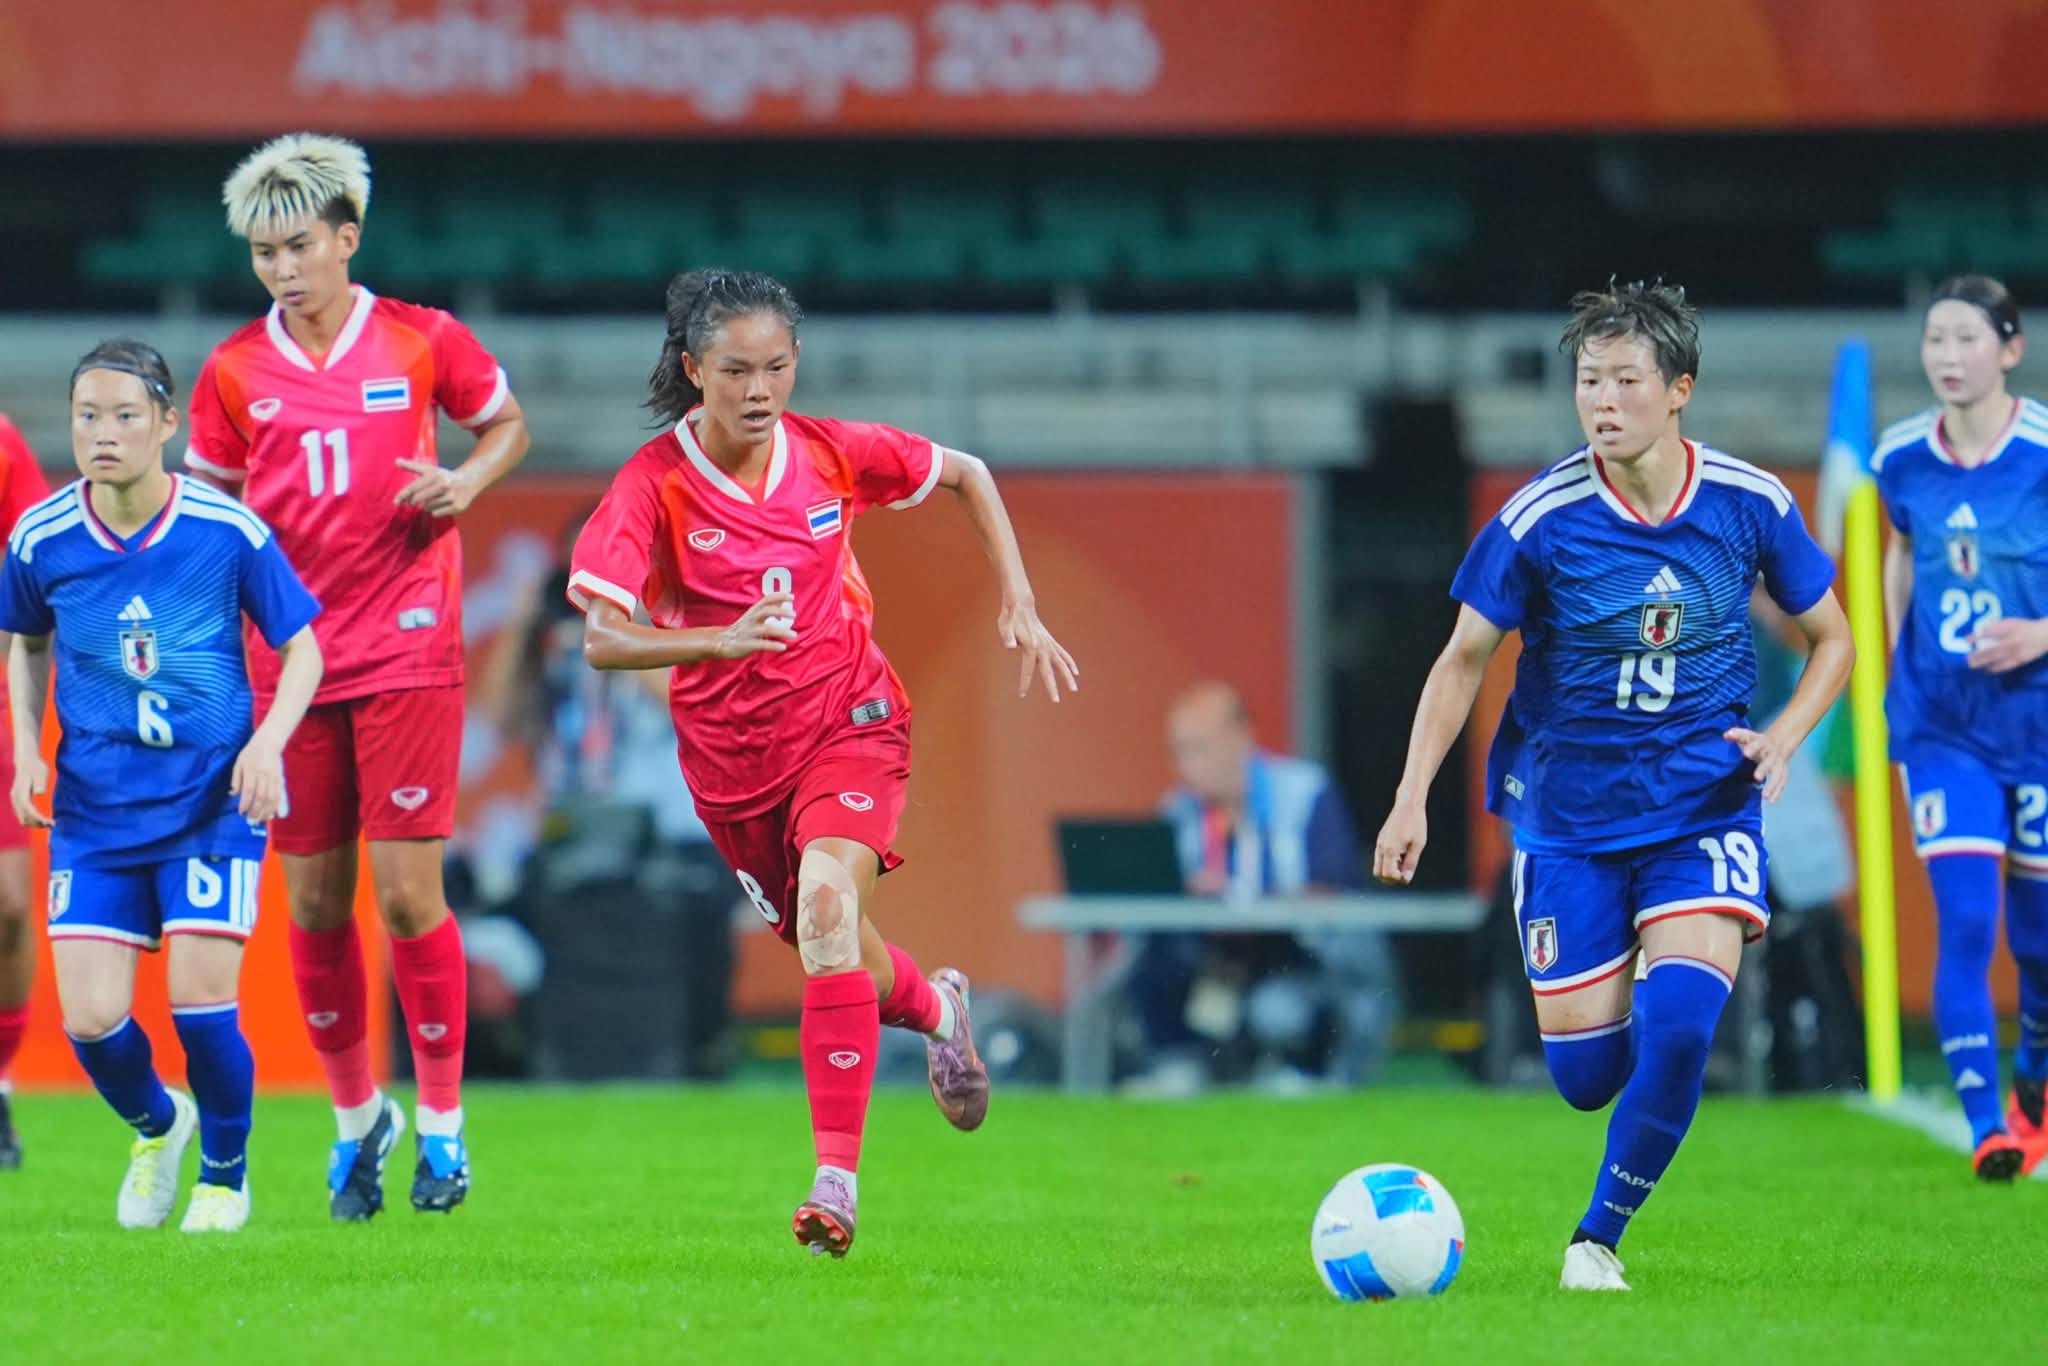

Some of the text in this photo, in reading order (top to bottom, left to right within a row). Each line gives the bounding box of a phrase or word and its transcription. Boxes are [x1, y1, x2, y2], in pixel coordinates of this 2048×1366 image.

[293, 3, 1160, 116] Aichi-Nagoya 2026
[301, 428, 349, 497] 11
[1939, 588, 2003, 654] 22
[1615, 650, 1677, 713] 19
[137, 689, 174, 748] 6
[2015, 784, 2048, 848] 2
[186, 857, 223, 908] 6
[1698, 831, 1761, 897] 19
[735, 868, 780, 924] 8
[1609, 1162, 1656, 1189] JAPA
